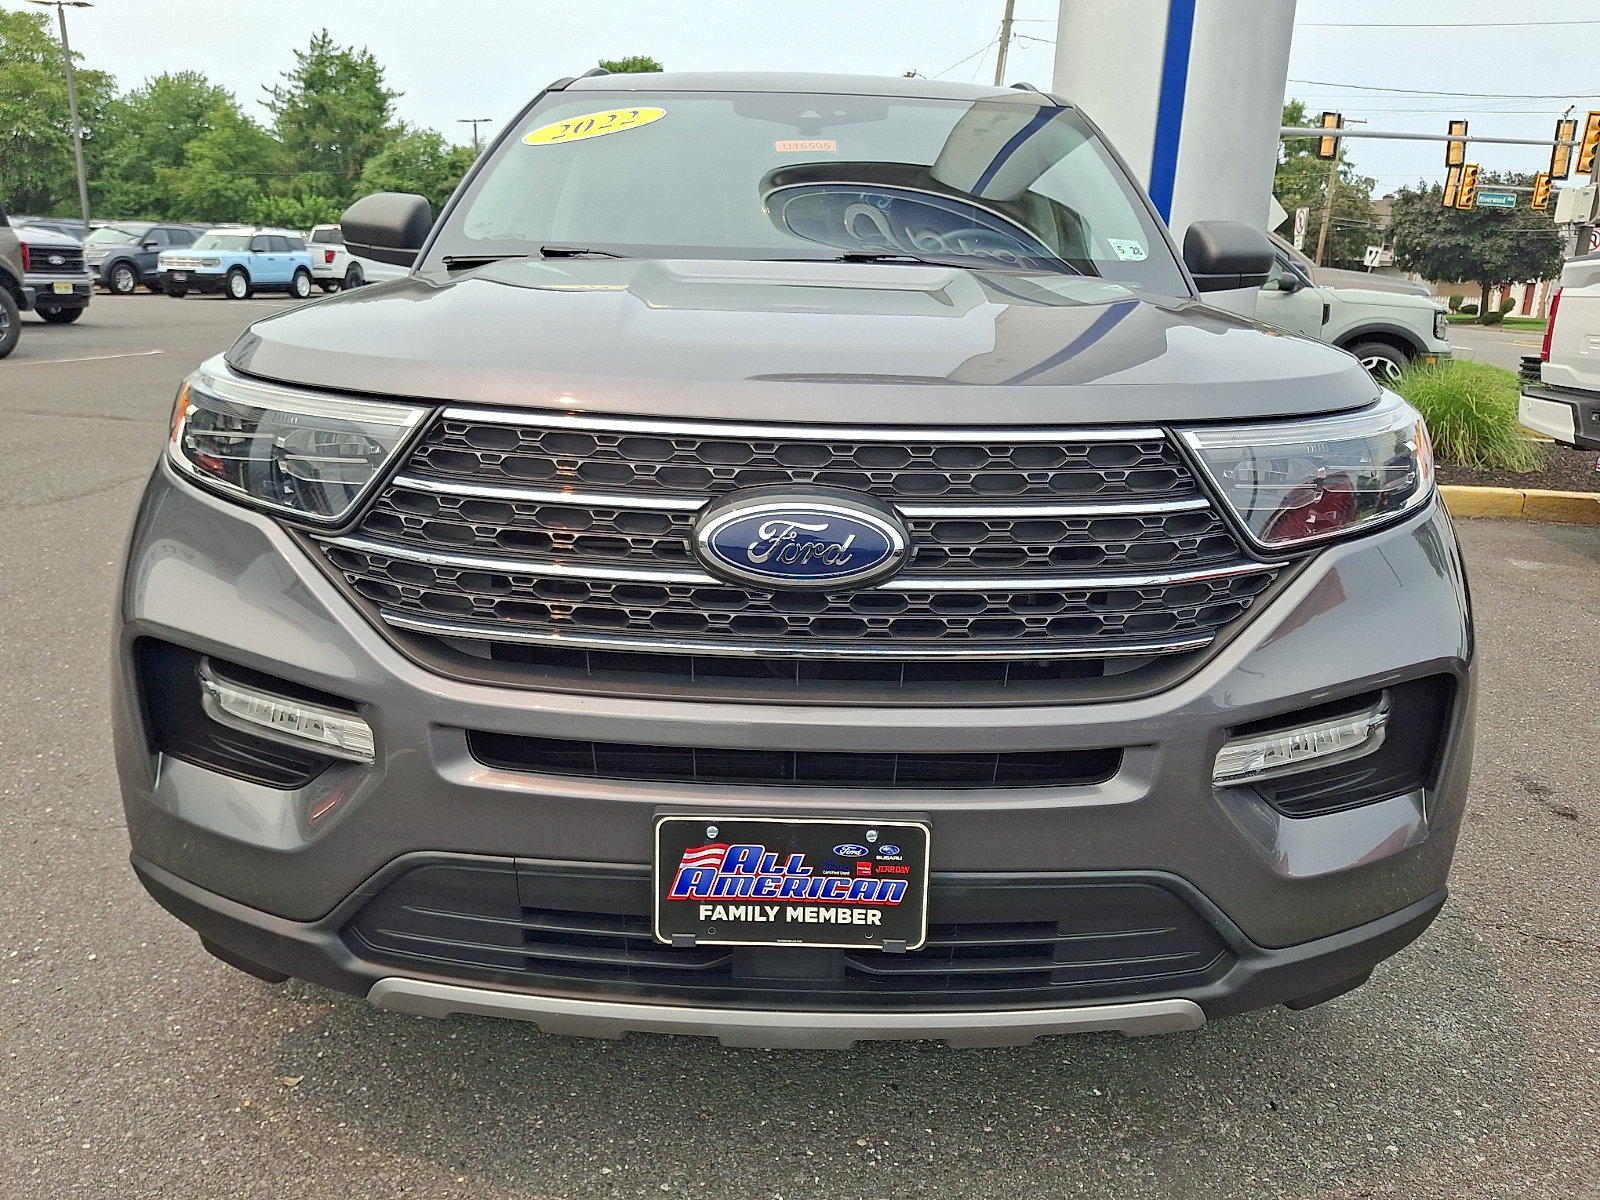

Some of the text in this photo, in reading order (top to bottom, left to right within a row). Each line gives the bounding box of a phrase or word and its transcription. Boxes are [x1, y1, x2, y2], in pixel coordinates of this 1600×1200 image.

[551, 111, 639, 140] 2022
[1117, 246, 1125, 254] 5
[747, 520, 855, 566] Ford
[840, 845, 862, 856] Ford
[700, 905, 882, 925] FAMILY MEMBER
